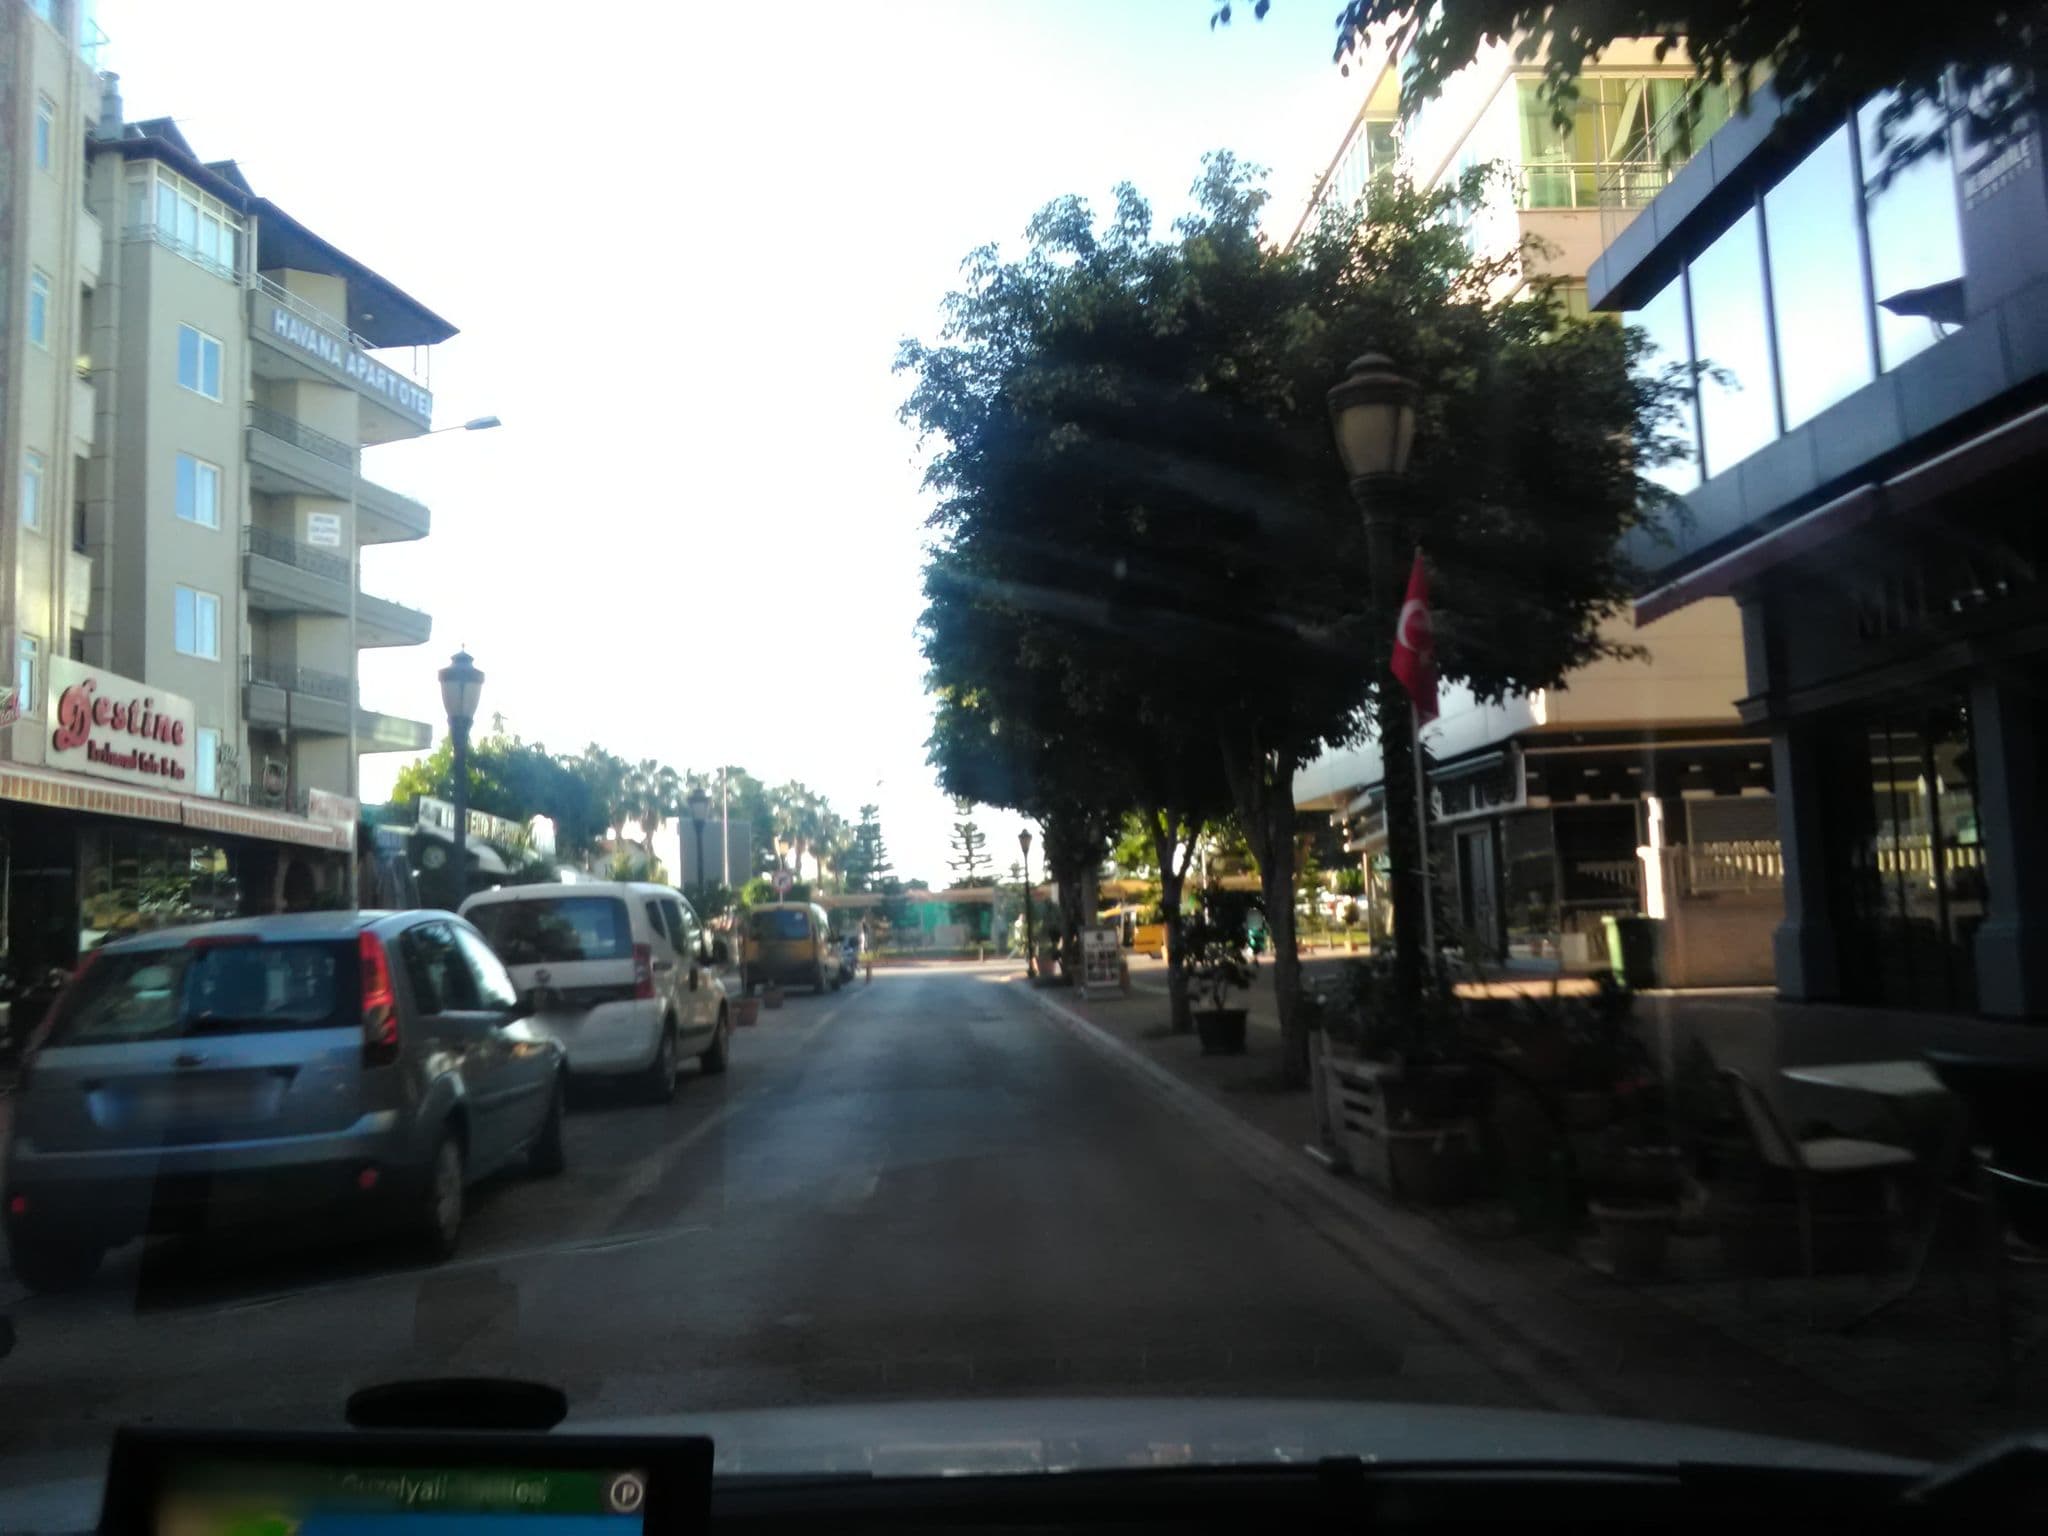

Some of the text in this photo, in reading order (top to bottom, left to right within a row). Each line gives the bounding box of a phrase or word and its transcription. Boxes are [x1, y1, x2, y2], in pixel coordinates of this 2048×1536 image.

[272, 308, 343, 369] HAVANA
[344, 350, 398, 397] APART
[52, 677, 186, 752] Destine
